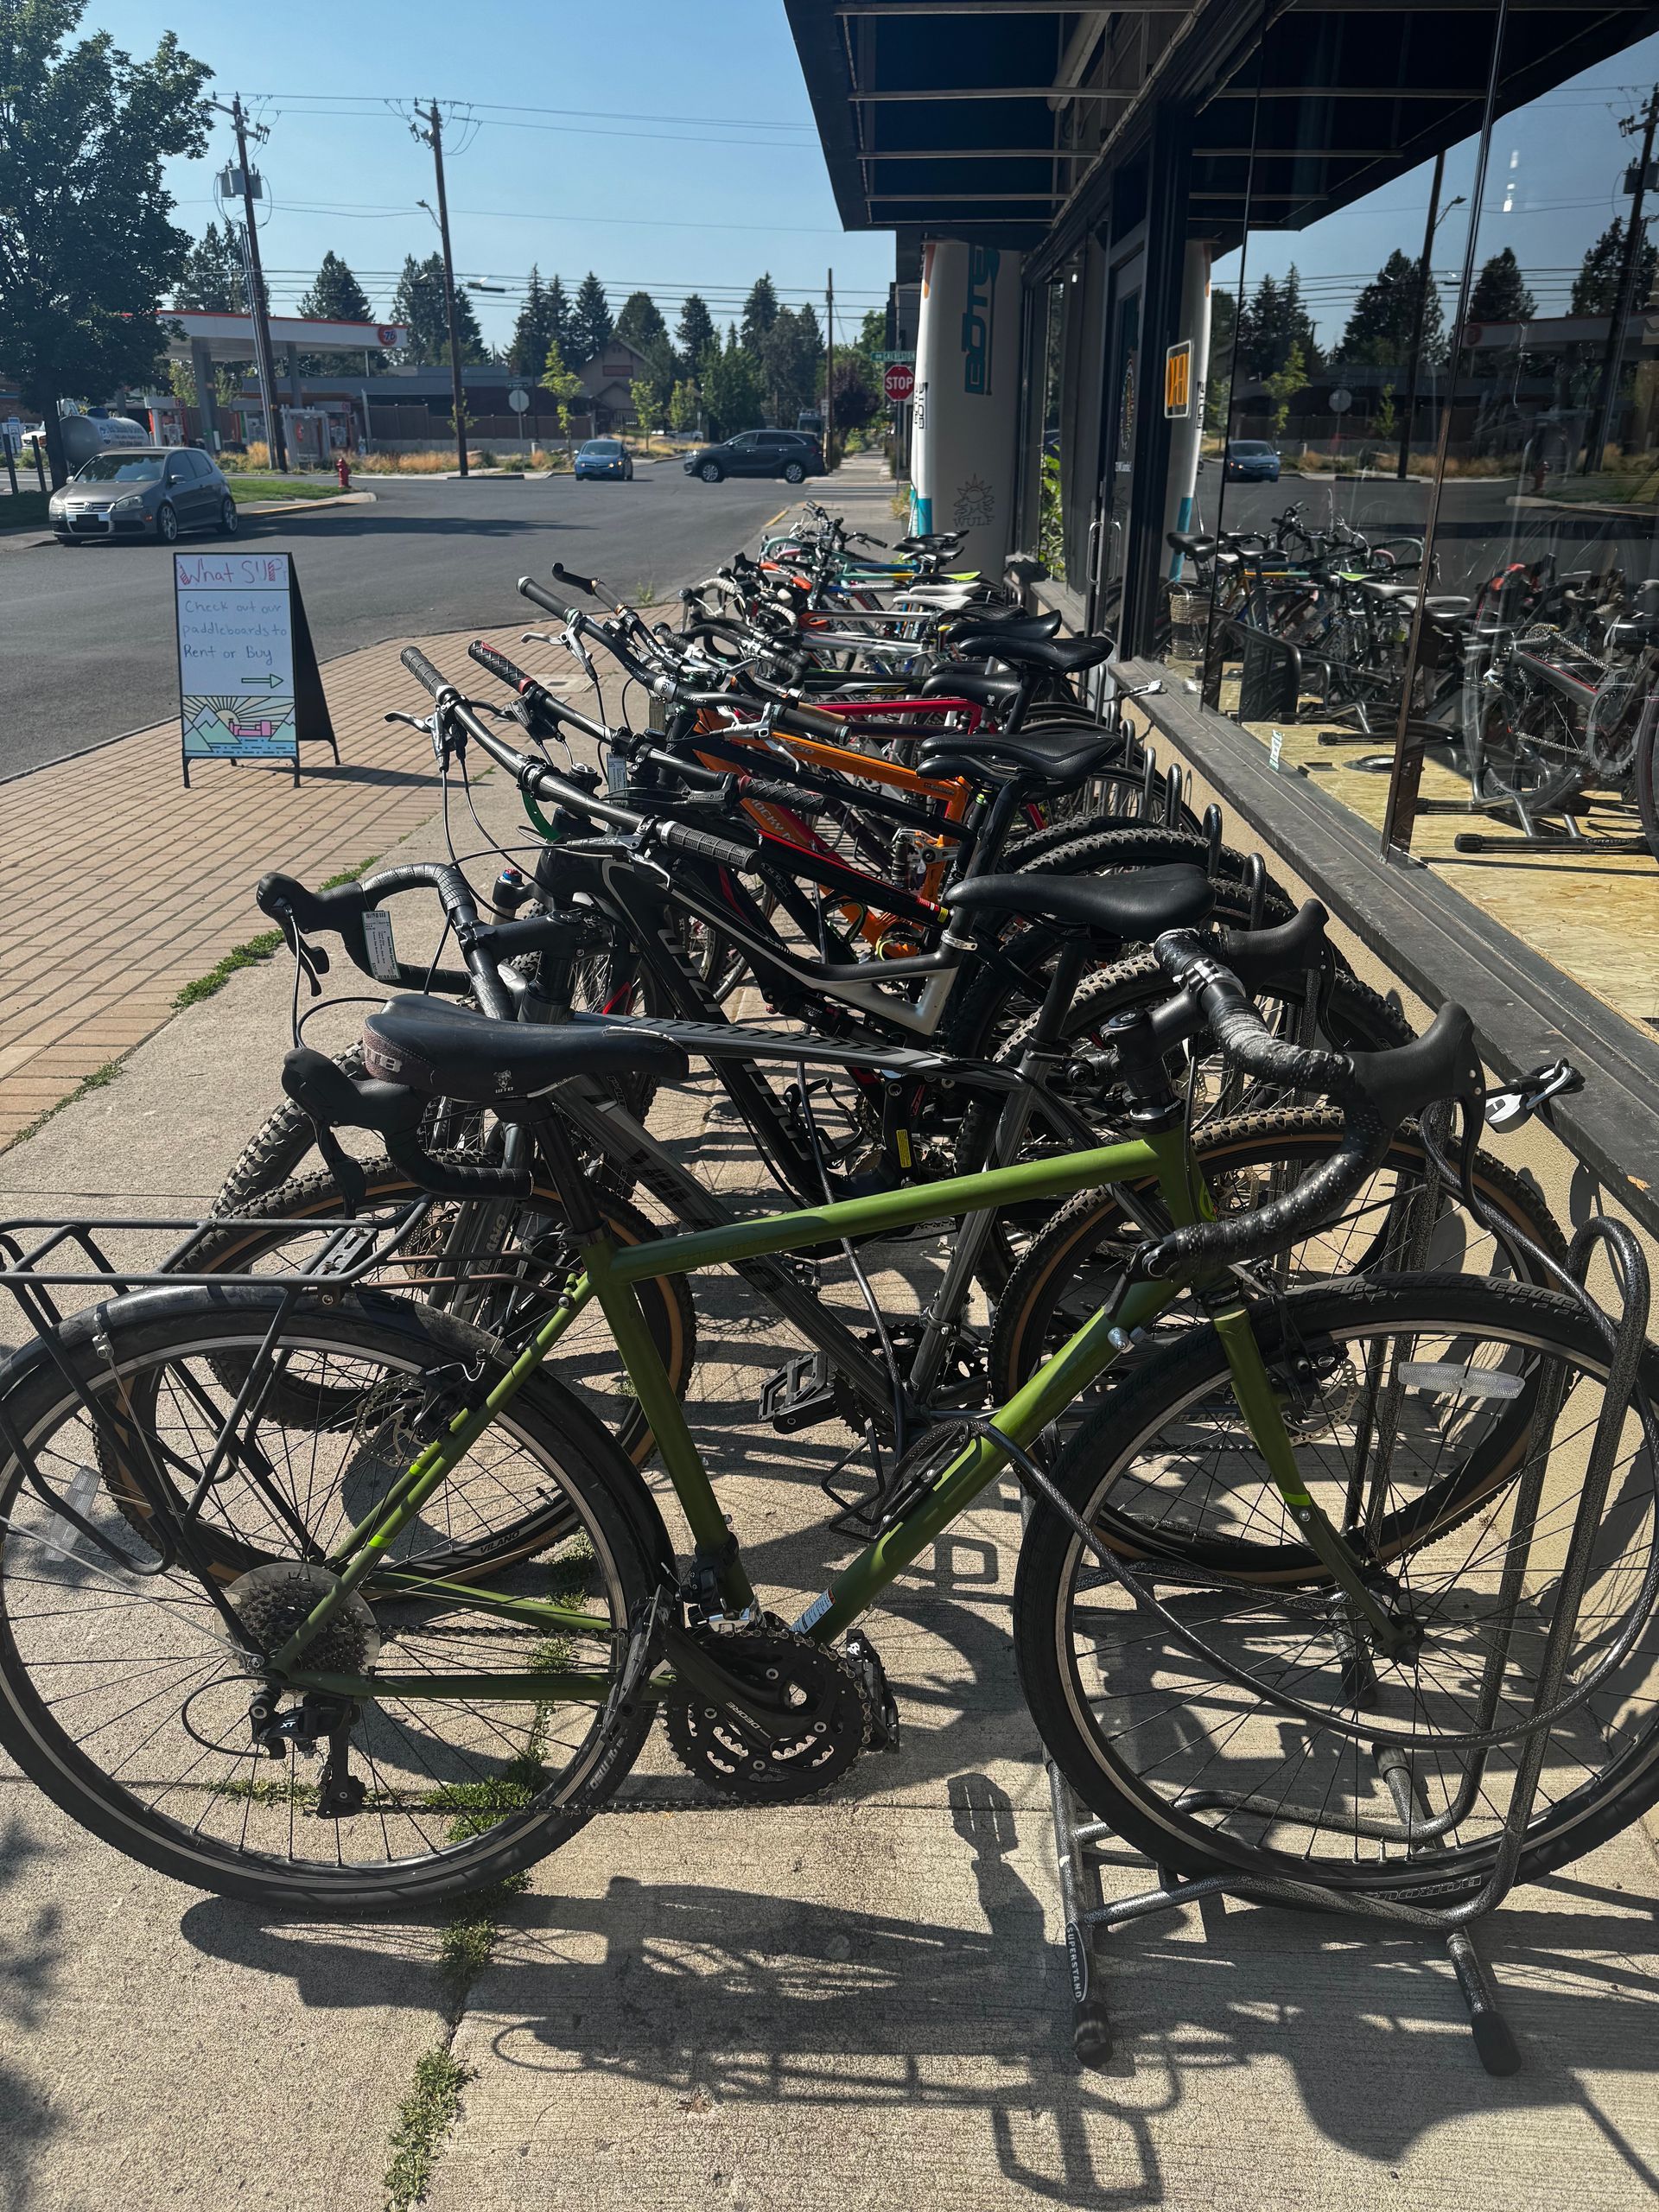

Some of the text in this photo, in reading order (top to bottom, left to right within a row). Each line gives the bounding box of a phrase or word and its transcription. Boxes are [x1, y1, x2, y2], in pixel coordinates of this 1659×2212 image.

[384, 331, 396, 340] 76
[886, 376, 914, 391] STOP
[953, 516, 995, 527] WULF
[176, 558, 235, 586] What
[185, 600, 282, 613] Check out our
[182, 622, 287, 638] paddleboards to
[183, 644, 217, 658] Rent
[246, 645, 273, 665] Buy
[478, 1530, 520, 1554] VILANO
[726, 1701, 761, 1730] DEORE
[1066, 1926, 1083, 1999] SUPERSTAND
